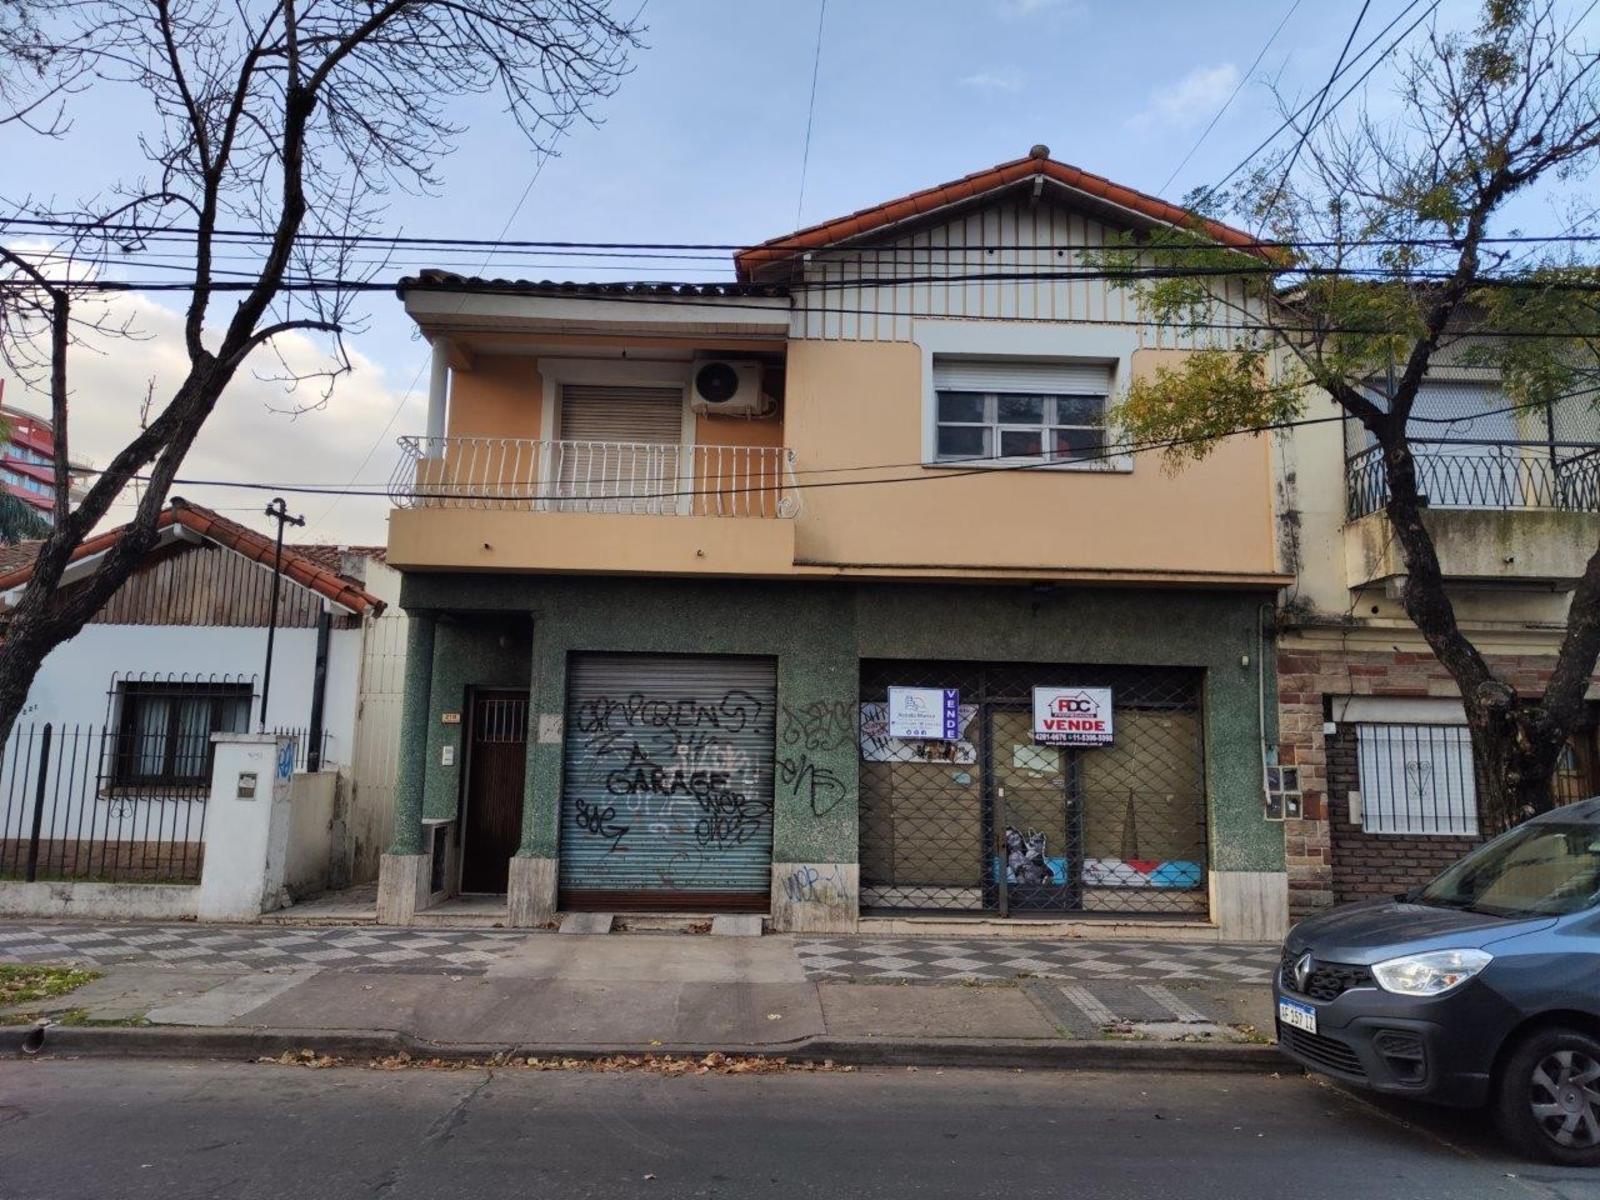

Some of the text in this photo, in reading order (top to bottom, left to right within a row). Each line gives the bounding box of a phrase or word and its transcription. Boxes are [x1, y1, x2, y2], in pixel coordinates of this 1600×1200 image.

[946, 690, 956, 738] VENDE
[1043, 719, 1106, 732] VENDE
[606, 768, 731, 796] GARAGE
